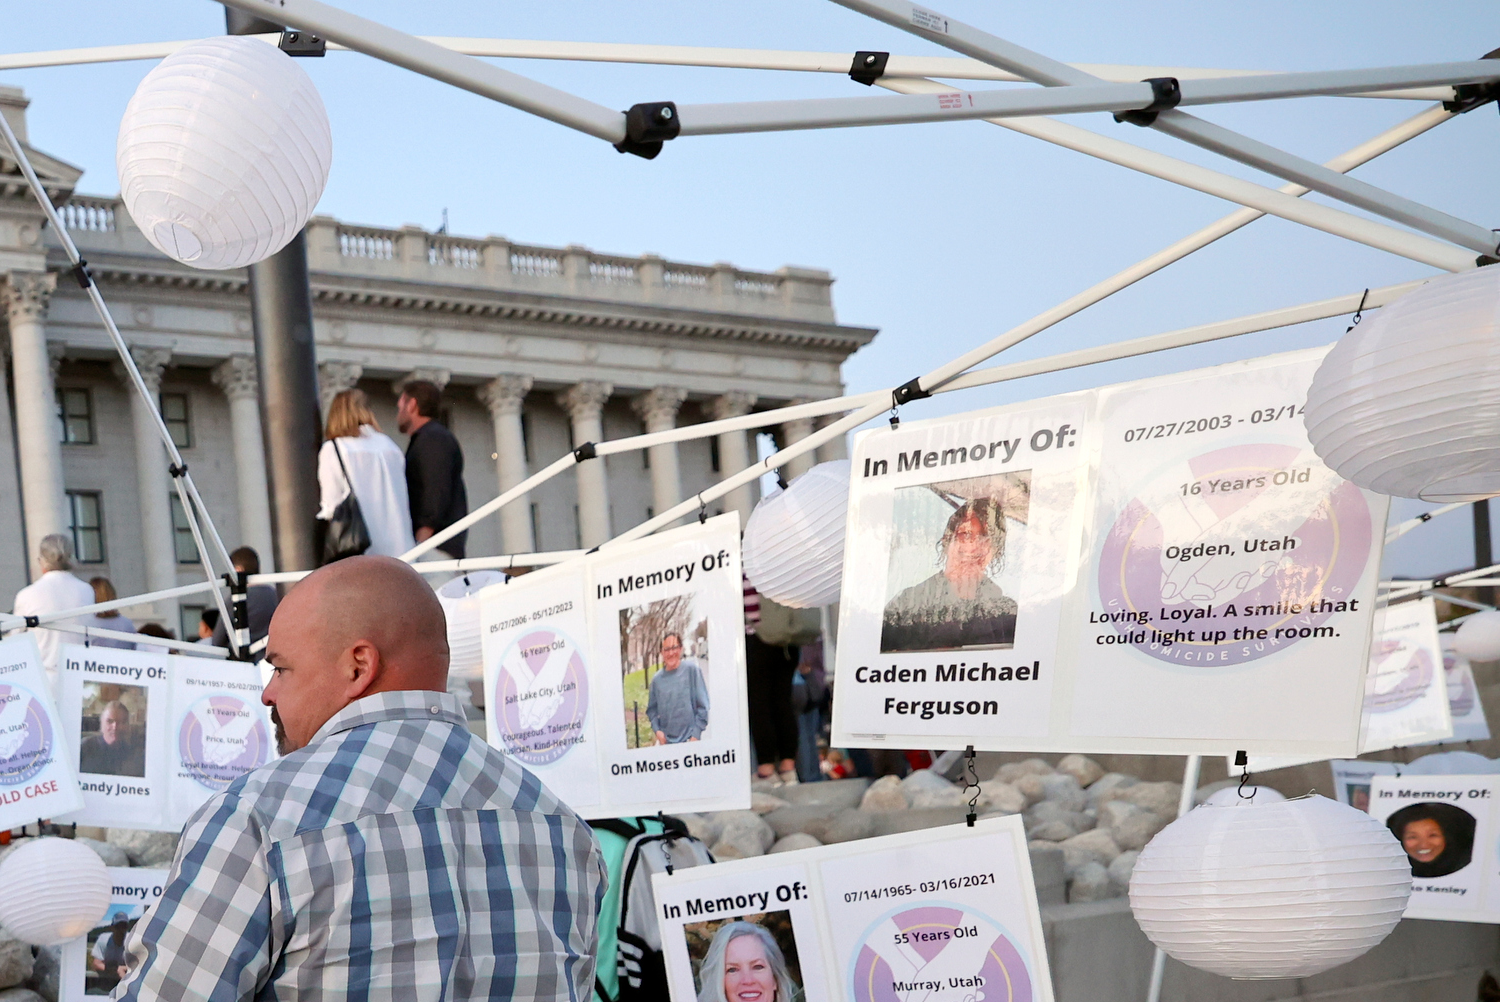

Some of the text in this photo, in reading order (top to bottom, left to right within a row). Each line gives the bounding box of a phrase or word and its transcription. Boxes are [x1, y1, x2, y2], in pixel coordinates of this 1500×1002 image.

[1124, 415, 1232, 443] 07/27/2003
[864, 425, 1077, 477] In Memory Of:
[1180, 468, 1311, 496] 16 Years Old
[1165, 536, 1296, 562] Ogden, Utah
[598, 562, 695, 599] In Memory
[532, 602, 573, 620] 05/12/2023
[1090, 599, 1358, 624] Loving. Loyal. A smile that
[1096, 626, 1340, 646] could light up the room.
[530, 644, 550, 657] Years
[66, 659, 142, 679] In Memory
[855, 661, 1040, 683] Caden Michael
[506, 682, 576, 704] Salt Lake Utah
[885, 698, 998, 719] Ferguson
[8, 722, 27, 733] Utah
[612, 750, 735, 776] Om Moses Ghandi
[25, 780, 58, 799] CASE
[115, 783, 150, 796] Jones
[1398, 790, 1462, 800] Memory
[920, 873, 996, 893] 03/16/2021
[663, 887, 769, 919] In Memory
[894, 925, 978, 945] 55 Years Old
[893, 976, 983, 993] Murray, Utah
